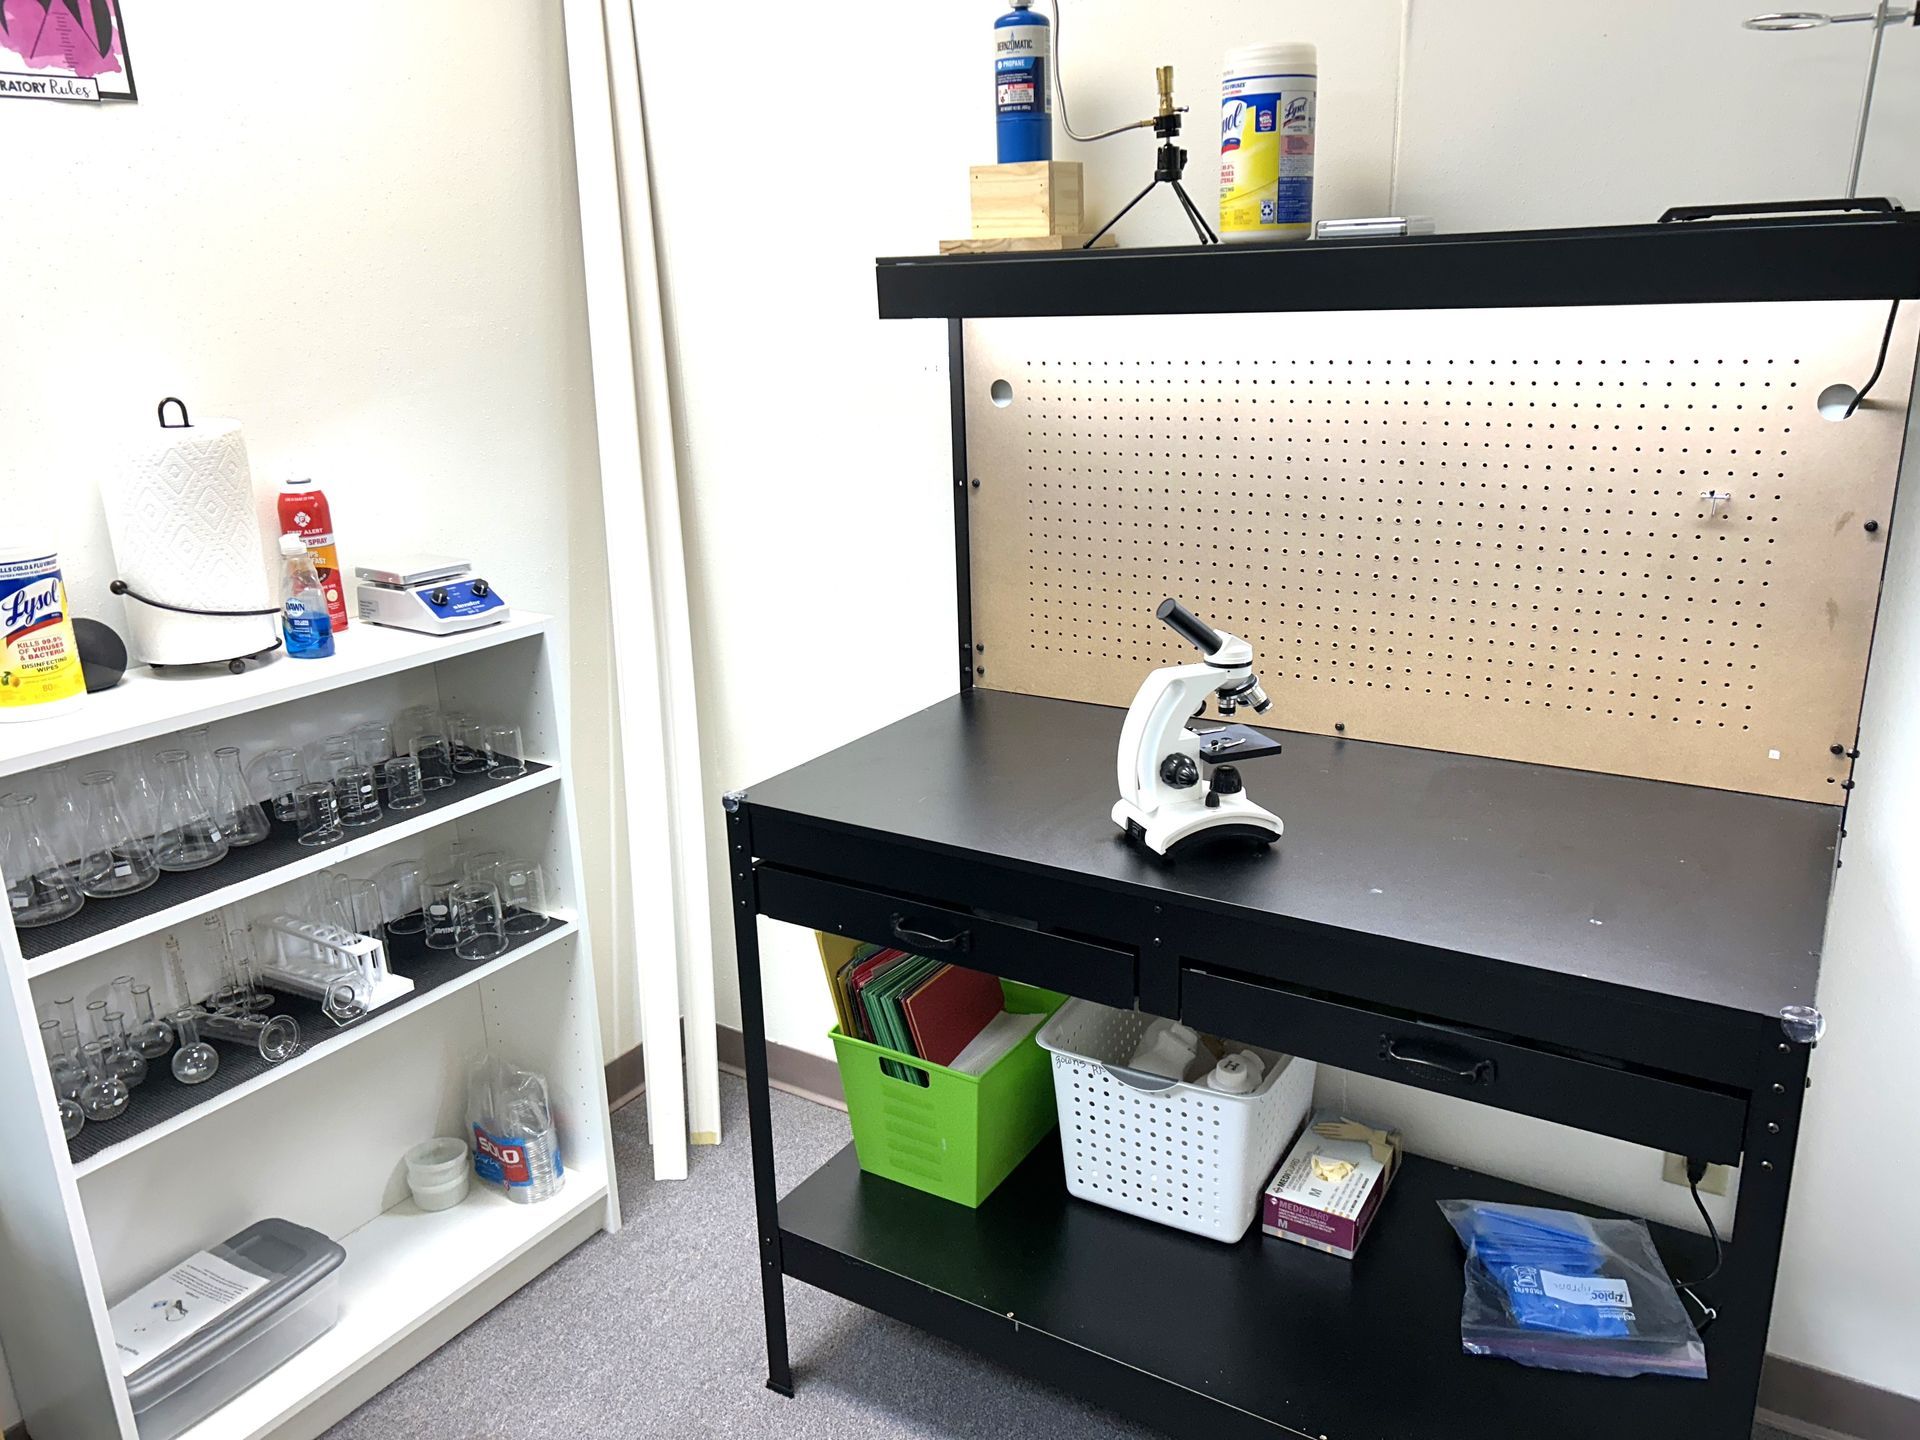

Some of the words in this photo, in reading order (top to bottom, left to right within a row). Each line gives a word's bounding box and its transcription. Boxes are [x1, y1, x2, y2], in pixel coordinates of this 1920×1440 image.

[1003, 59, 1025, 67] PROPANE
[50, 79, 91, 98] Rules
[309, 537, 328, 545] SPRAY
[2, 580, 57, 626] Lysol
[285, 602, 305, 611] DAWN
[17, 640, 40, 649] KILLS
[32, 642, 64, 653] VIRUSES
[28, 648, 65, 660] BACTERIA
[21, 656, 67, 670] DISINFECTING
[36, 664, 59, 673] WIPES
[1055, 1055, 1087, 1069] gowns
[478, 1136, 520, 1164] SOLO
[1308, 1188, 1323, 1198] M
[1280, 1201, 1329, 1221] MEDIGUARD
[1277, 1218, 1288, 1229] M
[1591, 1290, 1625, 1303] Ziploc
